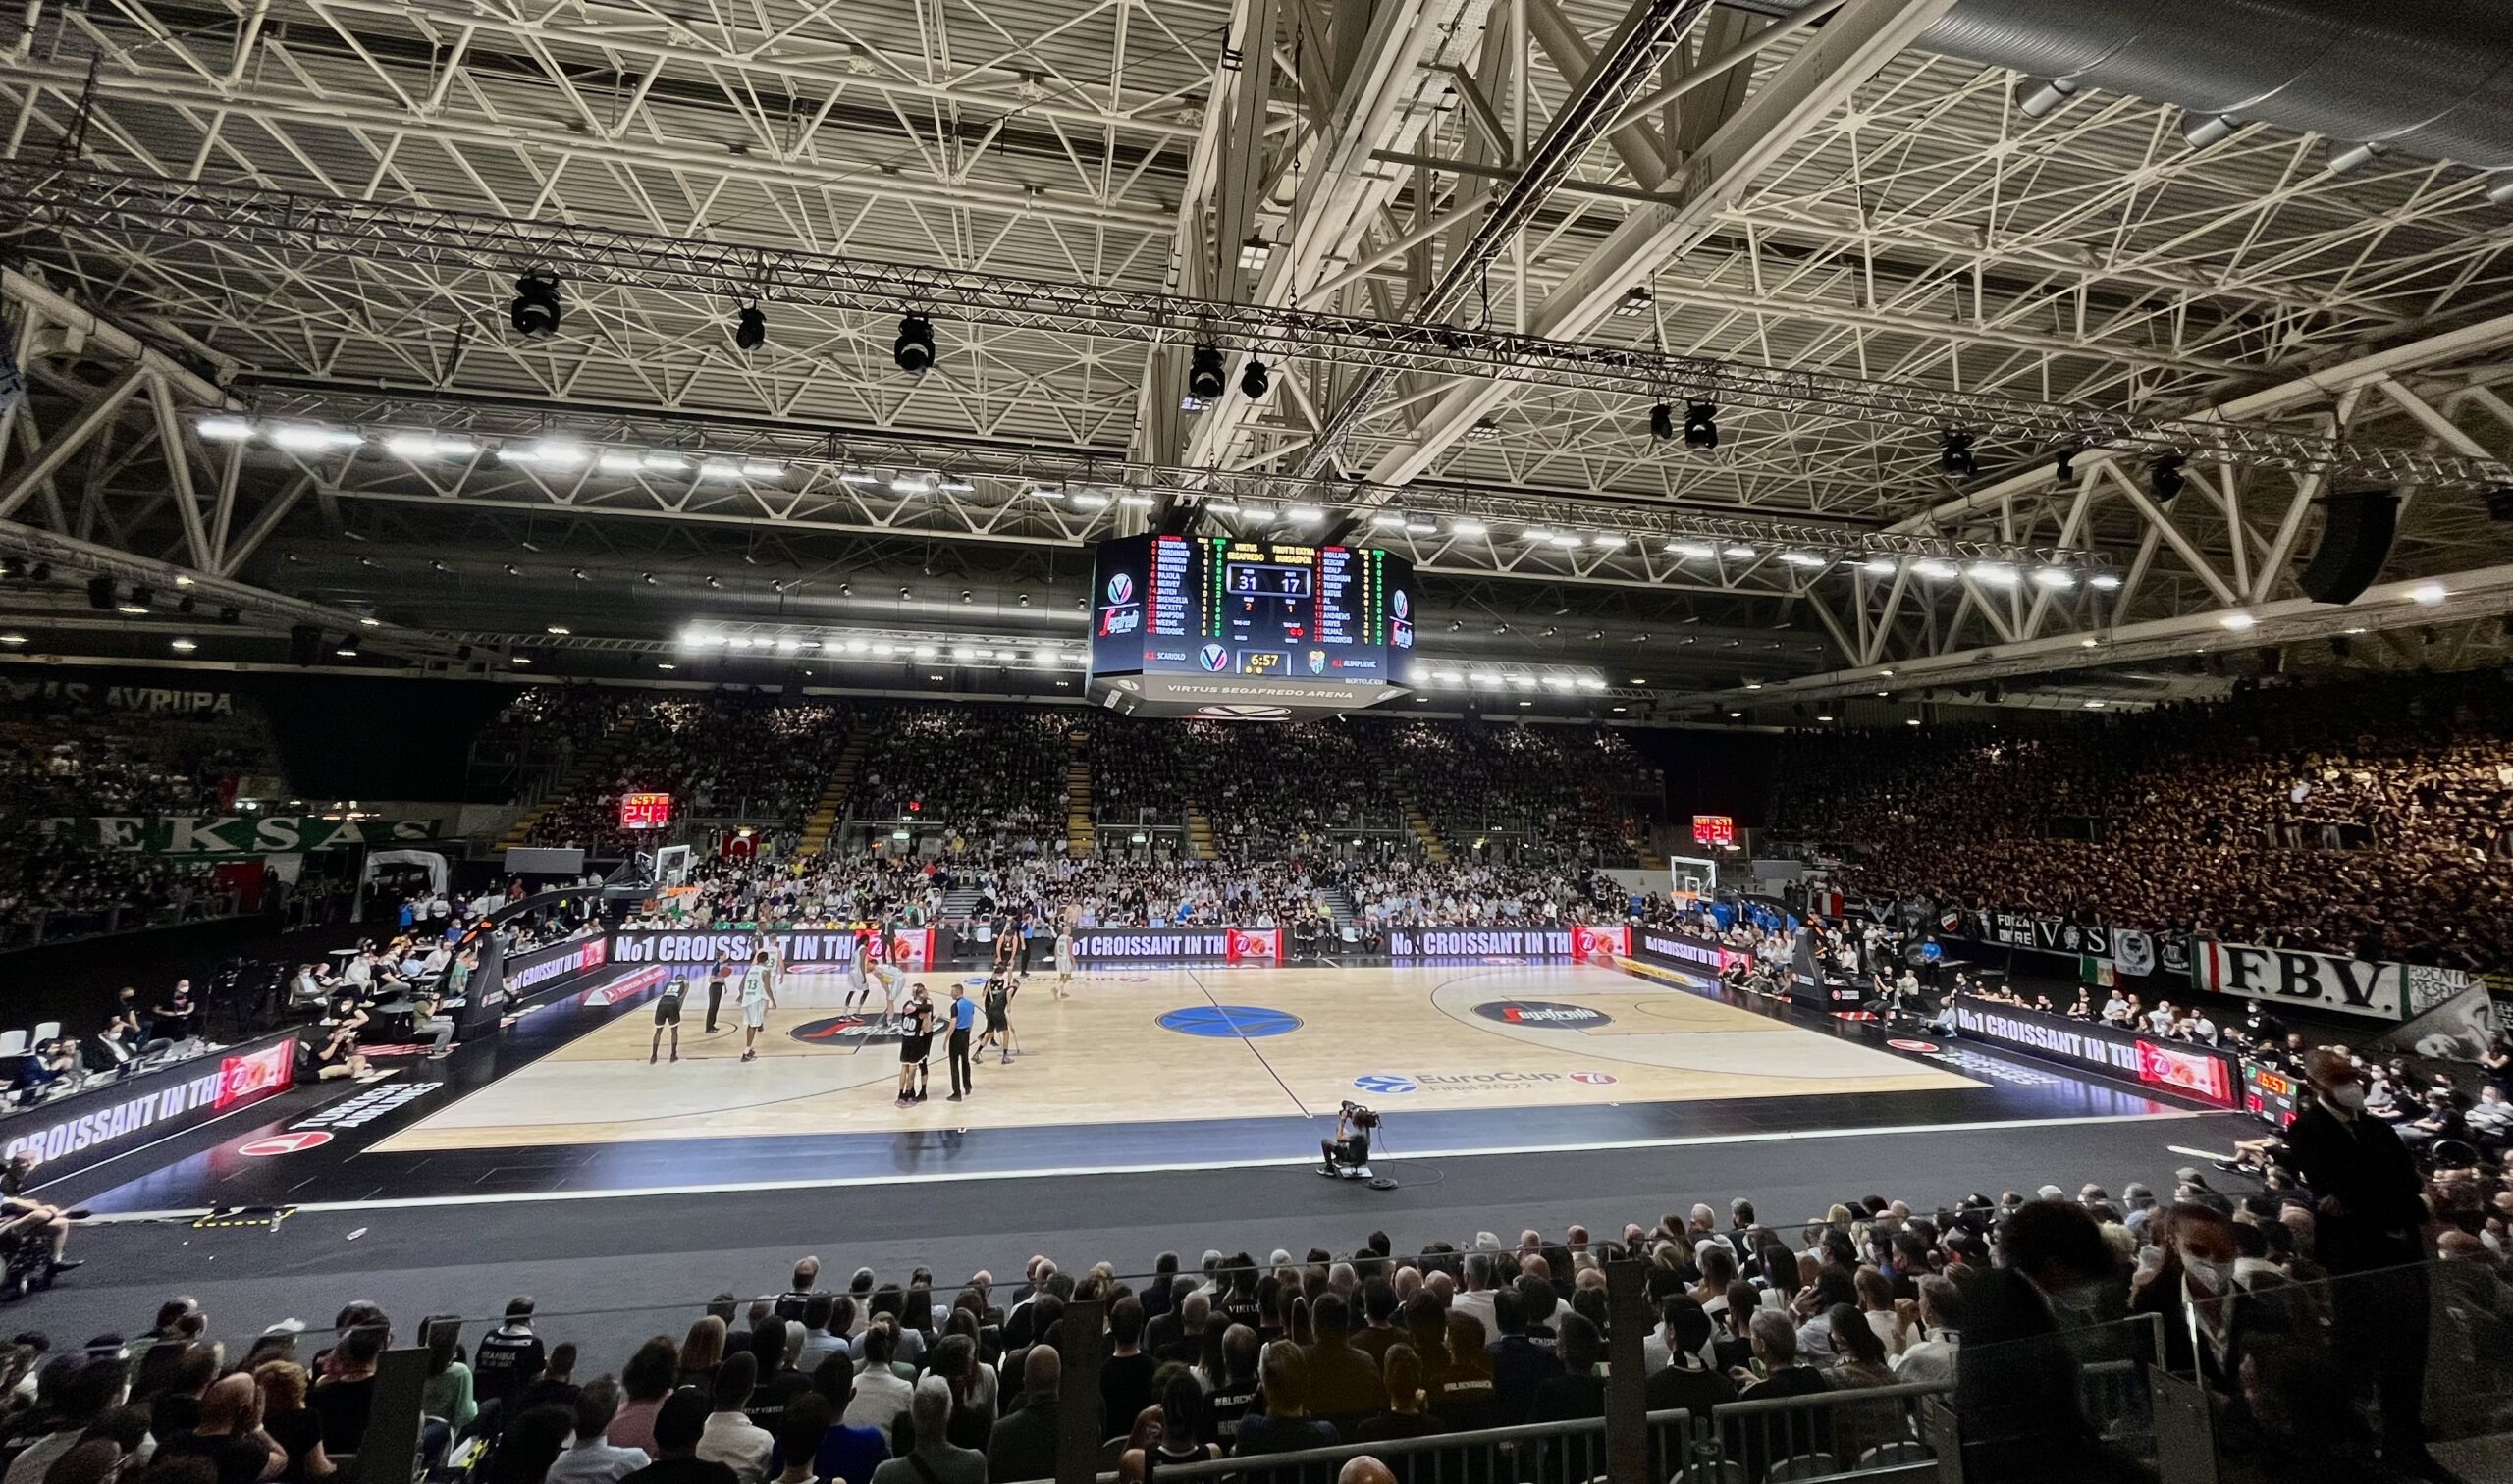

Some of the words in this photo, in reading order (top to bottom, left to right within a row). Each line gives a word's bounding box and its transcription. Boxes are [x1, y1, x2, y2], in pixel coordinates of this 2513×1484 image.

[1239, 576, 1256, 590] 31
[1282, 578, 1300, 592] 17
[1251, 655, 1279, 666] 6:57
[1221, 687, 1304, 696] SEGAFREDO
[1307, 690, 1353, 699] ARENA
[631, 796, 656, 805] 6:57
[623, 806, 653, 822] 24
[1712, 825, 1732, 841] 24
[615, 935, 661, 962] No1
[666, 935, 791, 962] CROISST
[793, 935, 819, 960] IN
[823, 935, 857, 960] TH
[1072, 935, 1089, 956] o1
[1091, 935, 1183, 956] CROISSANT
[1184, 935, 1202, 955] IN
[1203, 935, 1228, 955] TH
[1424, 931, 1523, 955] CROISSANT
[1525, 932, 1544, 954] IN
[1546, 932, 1573, 954] TH
[1658, 938, 1698, 961] CROISSANT
[747, 979, 758, 990] 13
[1958, 1008, 1985, 1033] No1
[1986, 1016, 2082, 1057] CROISSANT
[2084, 1036, 2108, 1064] IN
[1415, 1072, 1561, 1084] EuroCup
[5, 1092, 160, 1166] CROISSANT
[158, 1084, 187, 1121] IN
[1229, 1303, 1260, 1314] VIRTU
